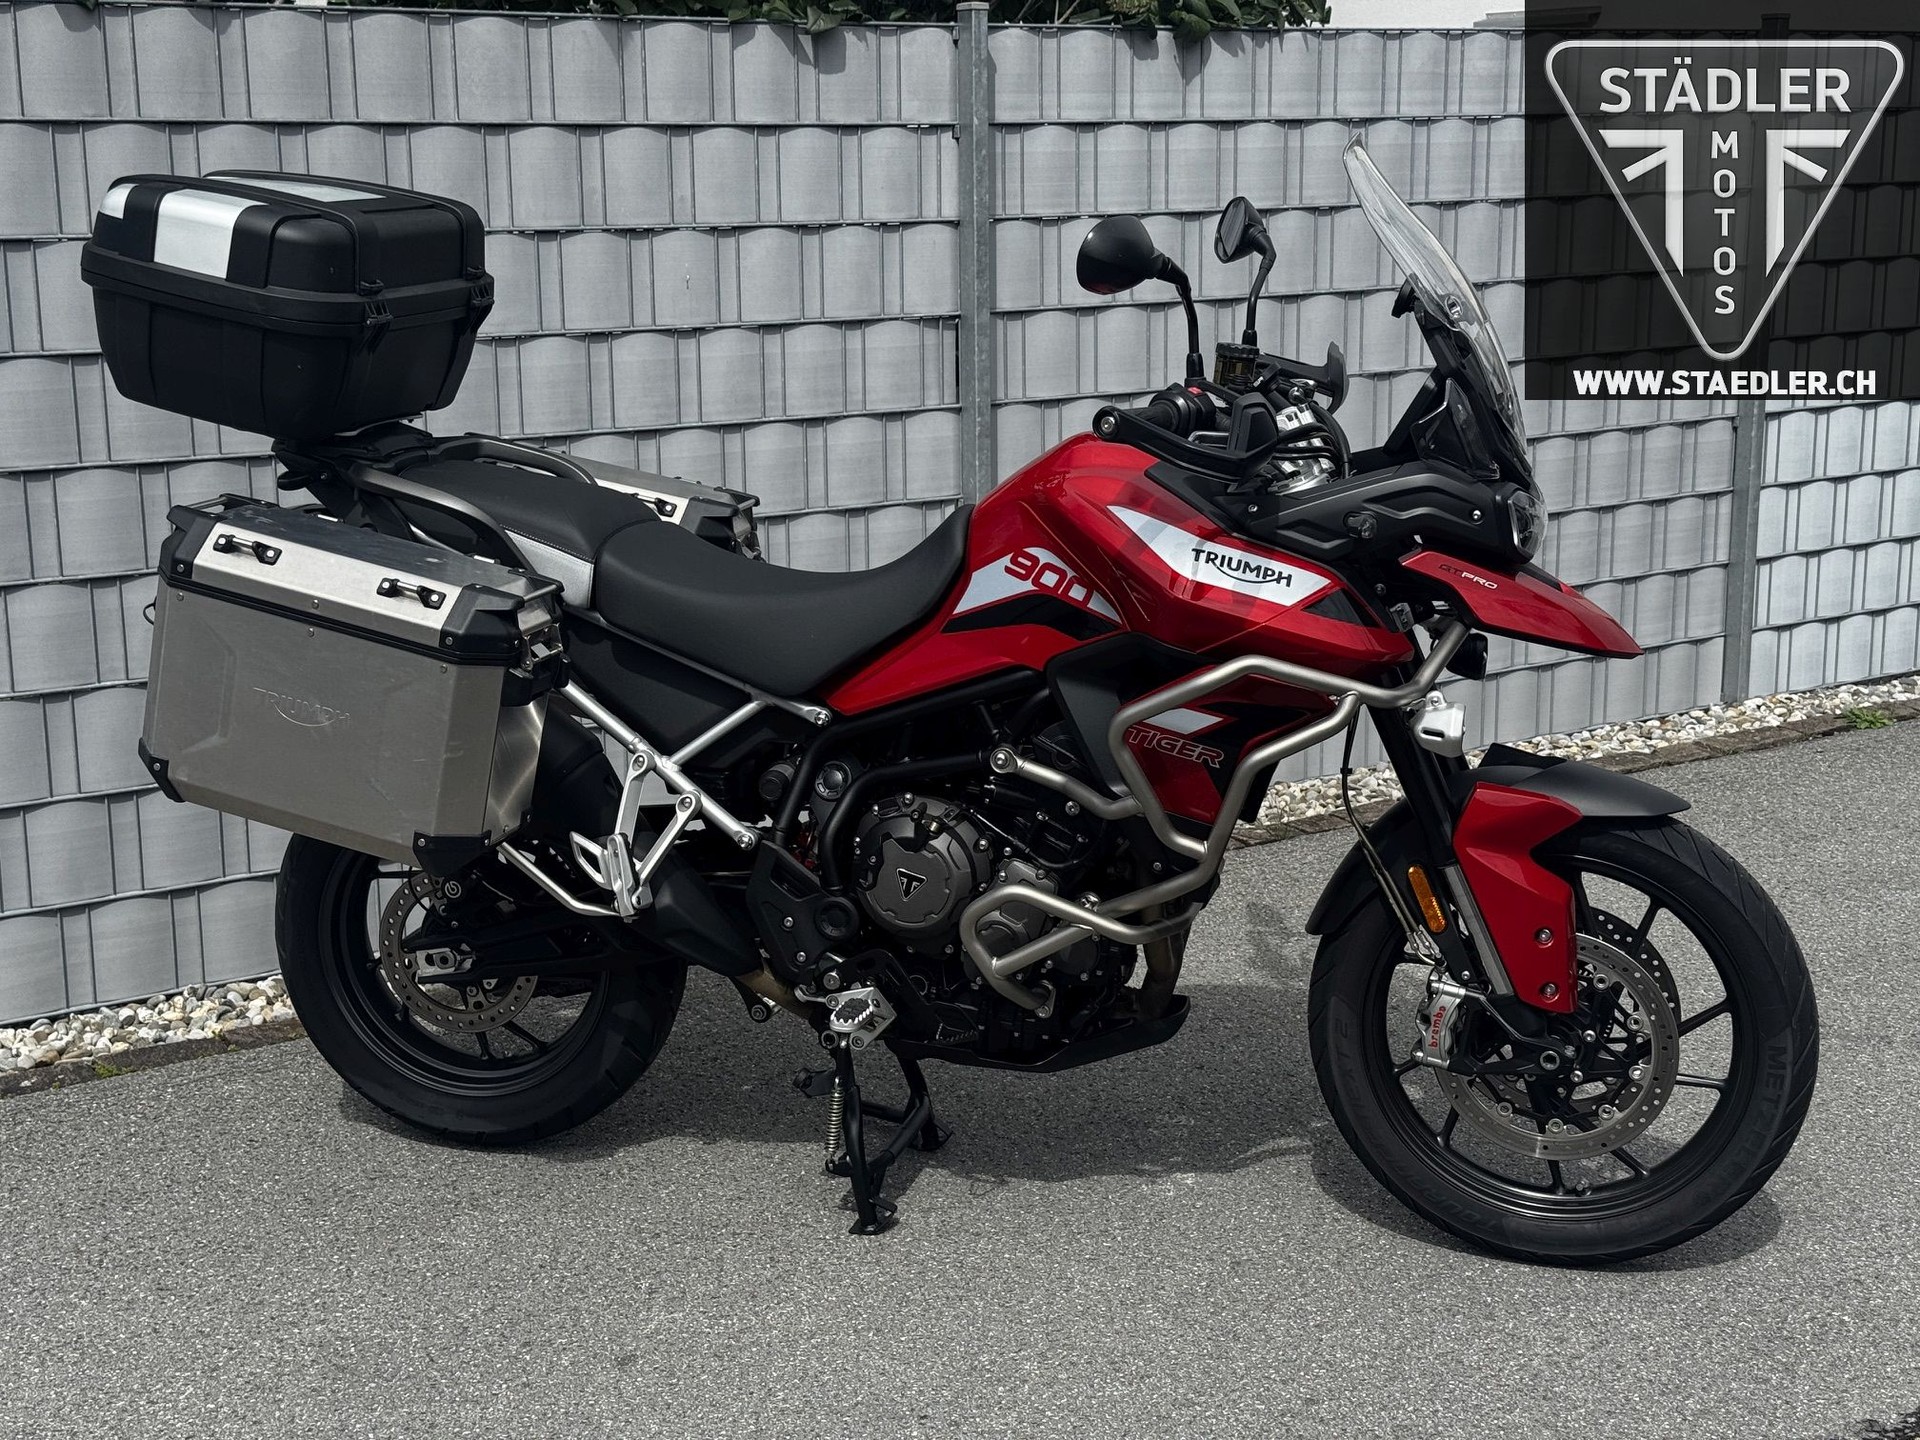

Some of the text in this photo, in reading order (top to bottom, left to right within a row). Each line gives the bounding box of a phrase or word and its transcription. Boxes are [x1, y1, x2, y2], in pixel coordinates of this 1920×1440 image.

[1004, 549, 1093, 607] 900
[1191, 548, 1293, 588] TRIUMPH
[1128, 724, 1225, 769] TIGER
[1428, 1005, 1447, 1048] brembo
